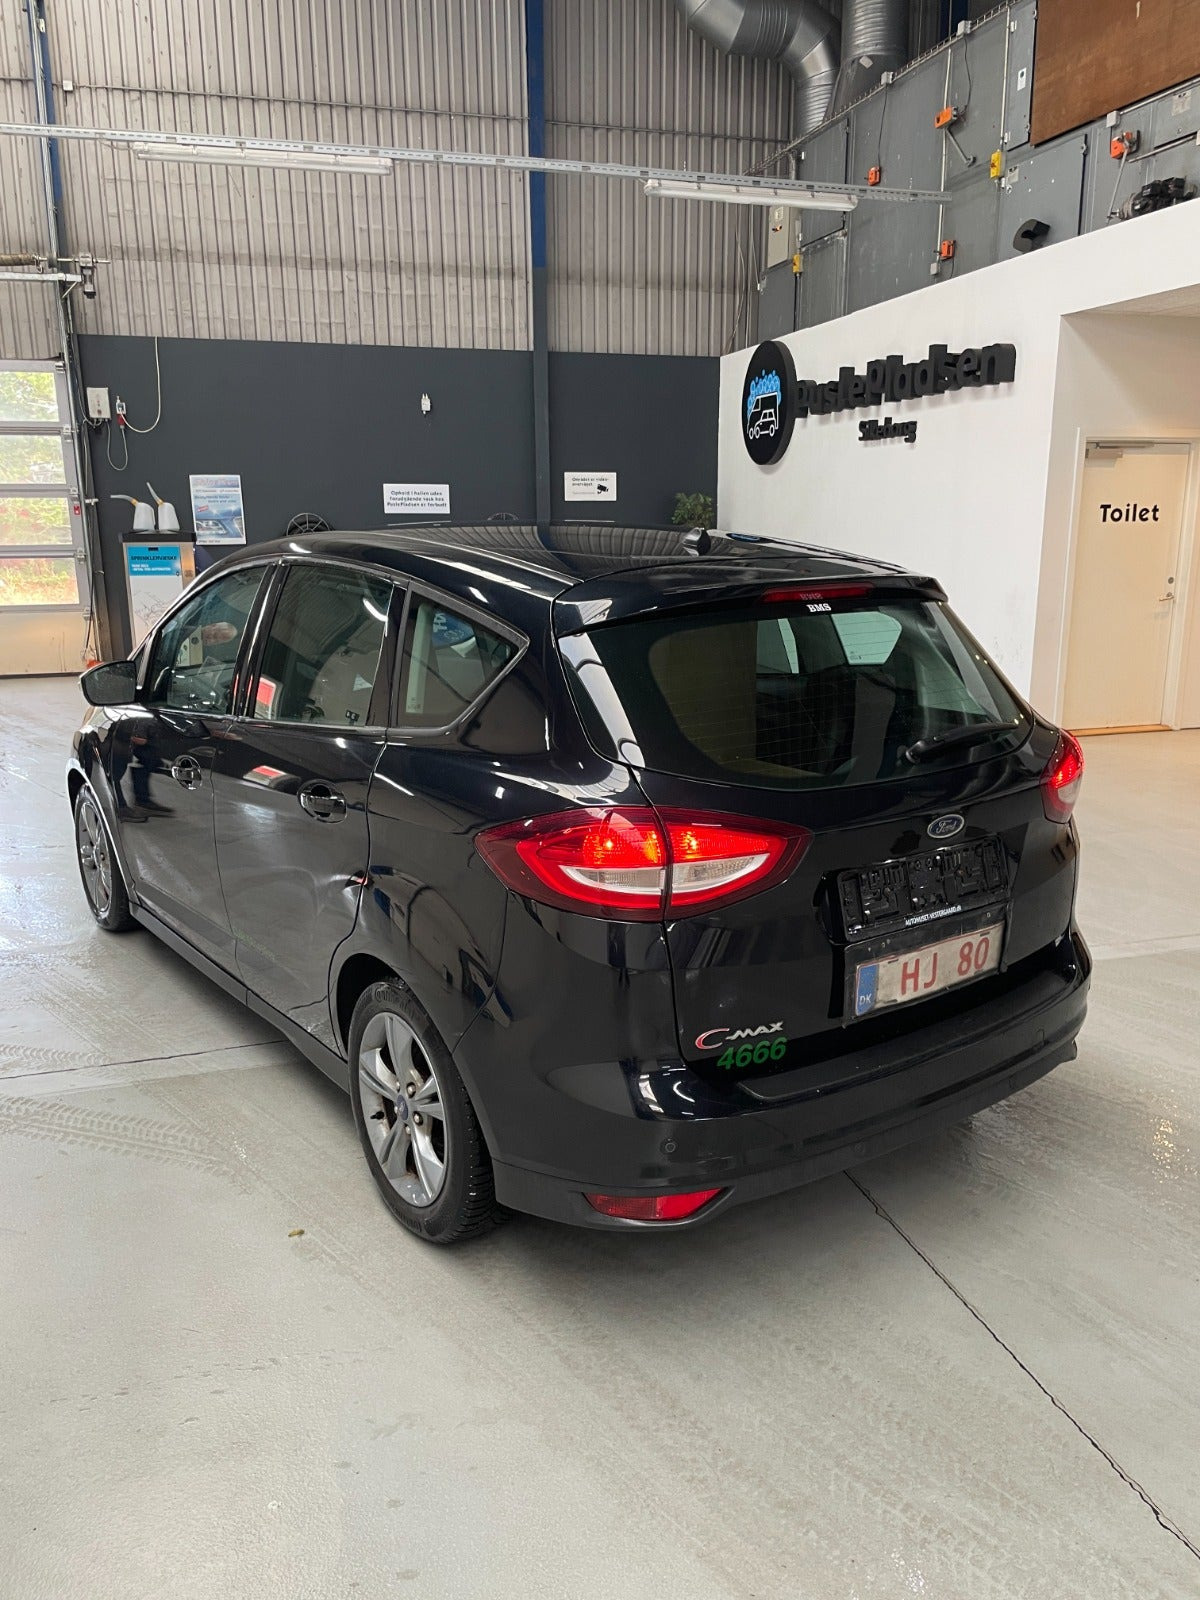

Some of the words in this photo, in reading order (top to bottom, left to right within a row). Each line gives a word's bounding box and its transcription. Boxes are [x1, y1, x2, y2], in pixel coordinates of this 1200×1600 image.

[1100, 503, 1159, 522] Toilet
[806, 603, 832, 612] BMS
[859, 993, 872, 1004] DK
[901, 952, 938, 995] HJ
[957, 937, 990, 977] 80
[717, 1037, 788, 1070] 4666
